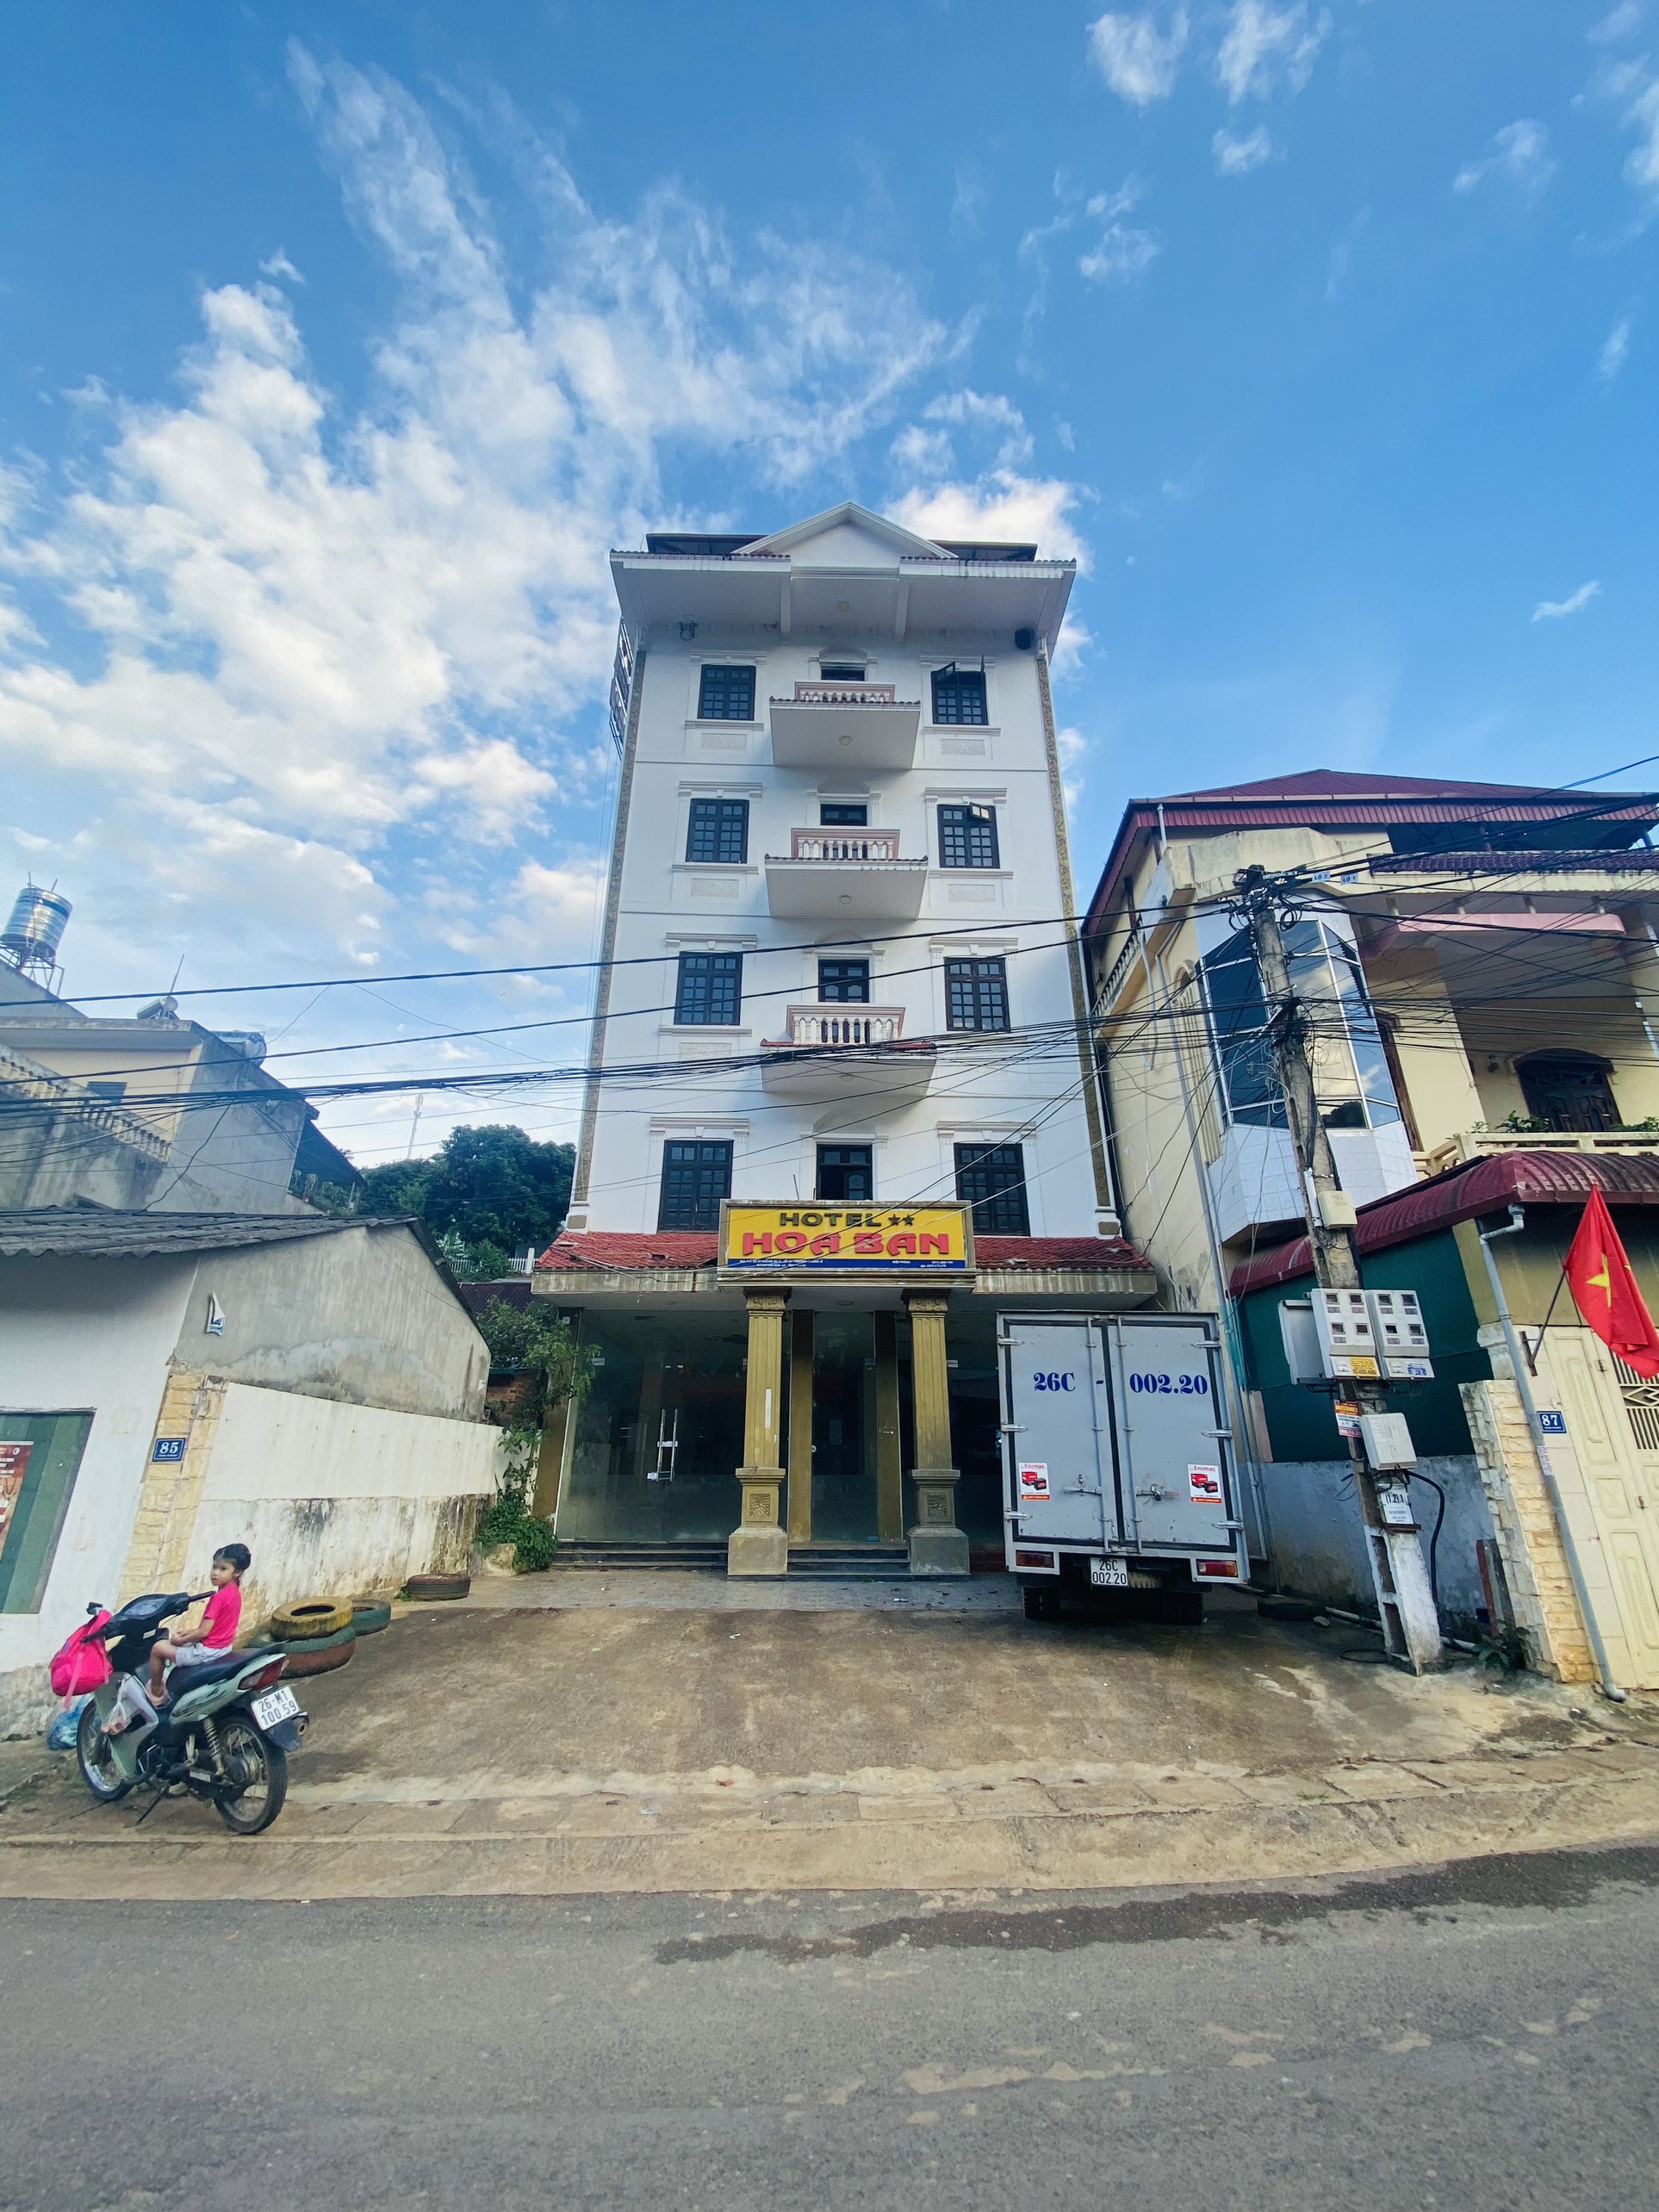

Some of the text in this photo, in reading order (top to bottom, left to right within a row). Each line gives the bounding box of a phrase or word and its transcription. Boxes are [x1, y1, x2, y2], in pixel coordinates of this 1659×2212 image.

[780, 1212, 882, 1227] HOTEL
[743, 1232, 949, 1256] HOA BAN
[1033, 1371, 1076, 1392] 26C
[1129, 1373, 1209, 1395] 002.20
[1541, 1414, 1558, 1426] 87
[159, 1441, 180, 1454] 85
[1098, 1559, 1119, 1572] 26C
[1092, 1571, 1127, 1585] 002.20
[258, 1690, 289, 1712] 26-M1
[261, 1700, 297, 1726] 100.59
